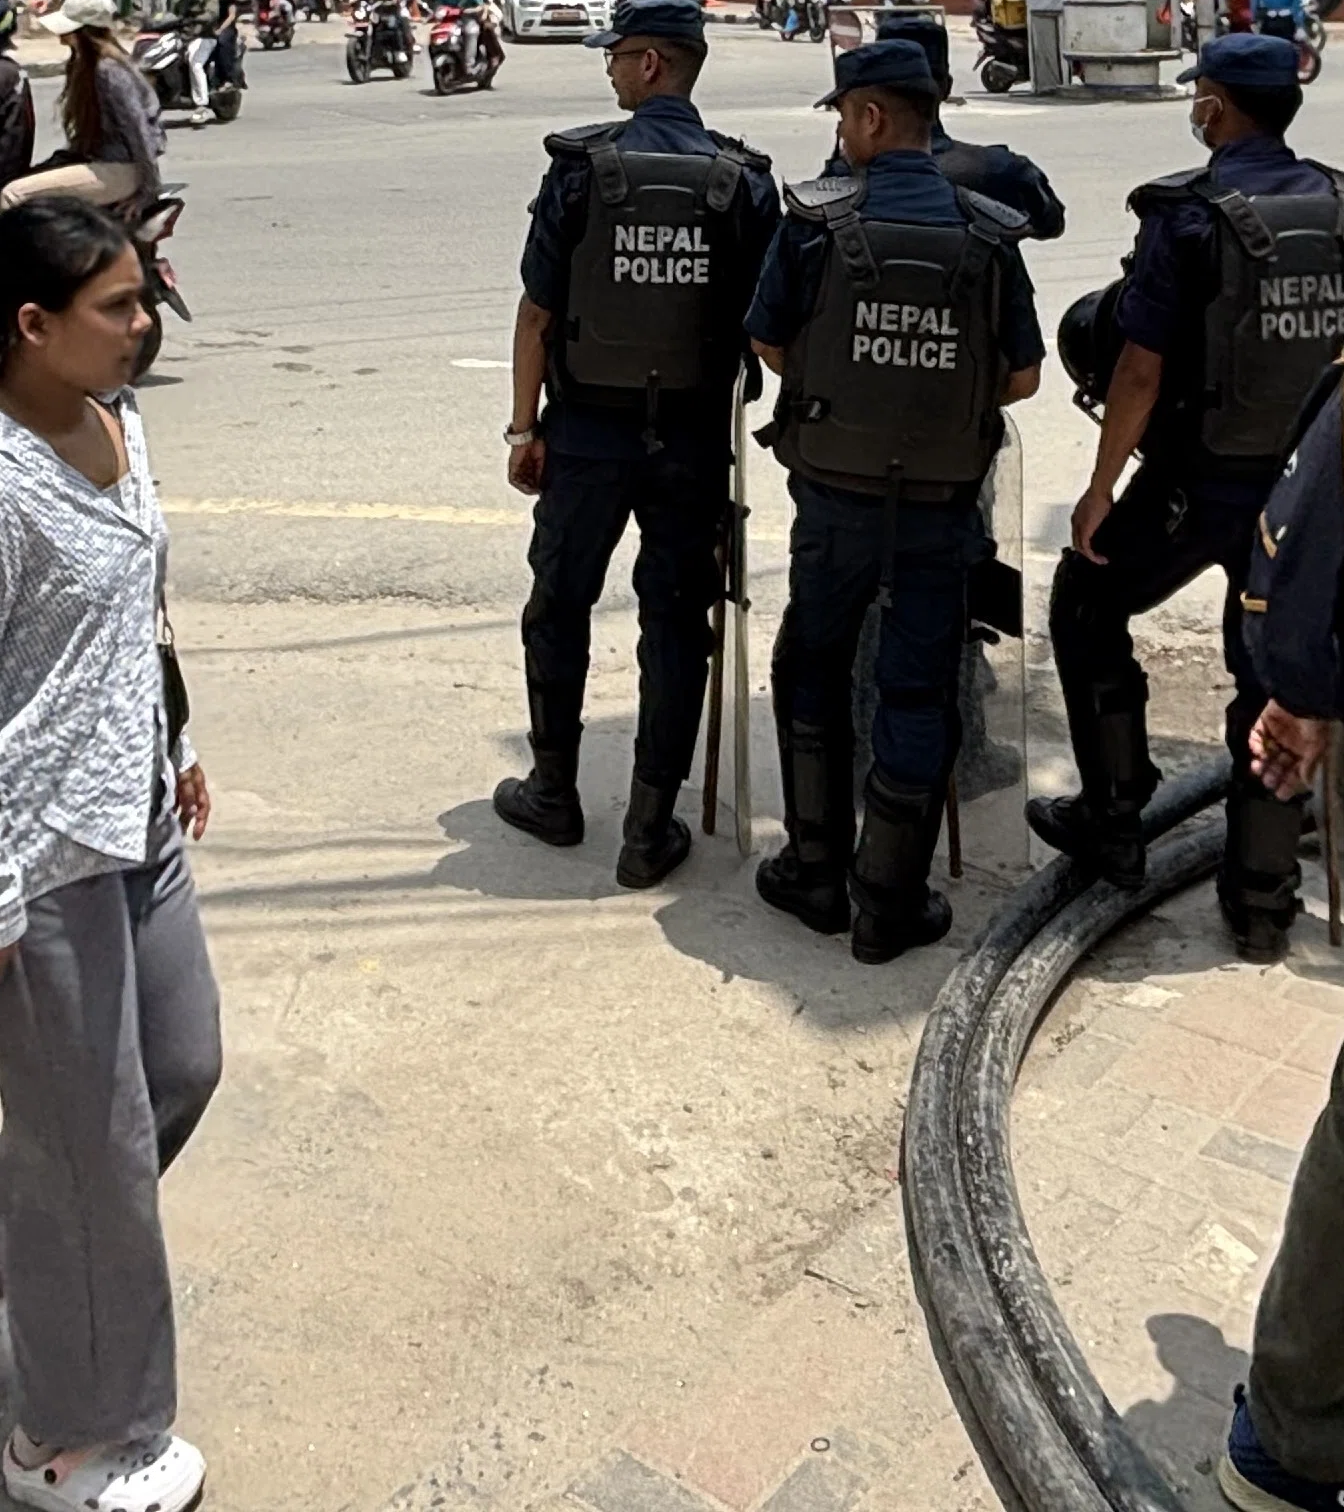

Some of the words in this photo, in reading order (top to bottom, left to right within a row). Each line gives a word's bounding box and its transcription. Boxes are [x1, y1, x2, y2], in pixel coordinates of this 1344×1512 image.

[615, 225, 710, 252] NEPAL
[614, 256, 709, 283] POLICE
[856, 301, 959, 336] NEPAL
[853, 334, 957, 369] POLICE
